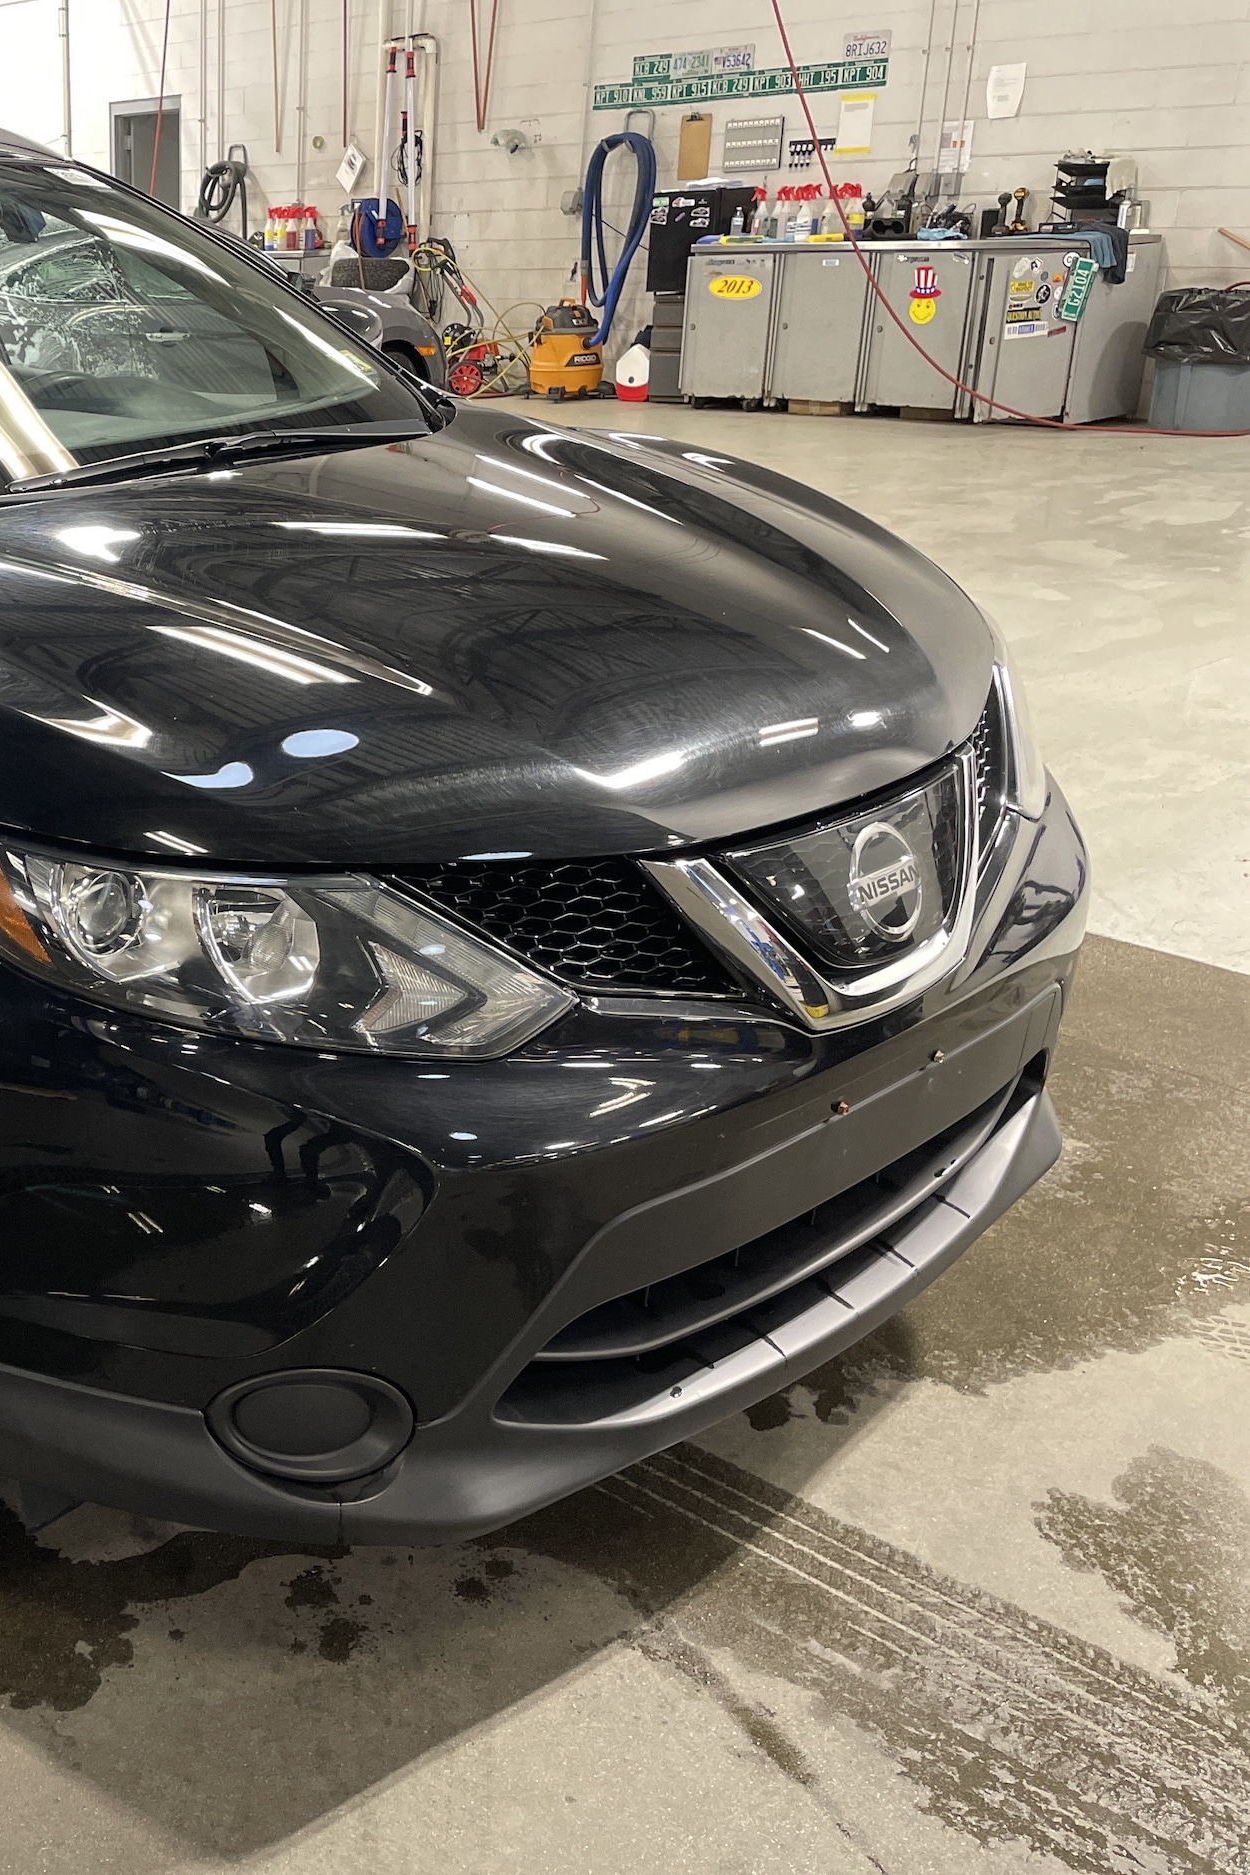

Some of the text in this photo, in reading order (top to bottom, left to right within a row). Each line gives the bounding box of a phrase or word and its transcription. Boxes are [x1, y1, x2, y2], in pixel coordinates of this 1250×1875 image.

[845, 41, 887, 57] 8RIJ632
[653, 61, 669, 74] 249
[842, 65, 884, 83] KPT 904
[732, 78, 748, 92] 249
[753, 73, 791, 91] KPT 903
[819, 69, 837, 85] 195
[594, 89, 628, 105] KPT 910
[672, 82, 707, 99] KPT 915
[717, 279, 754, 294] 2013
[857, 864, 920, 902] NISSAN
